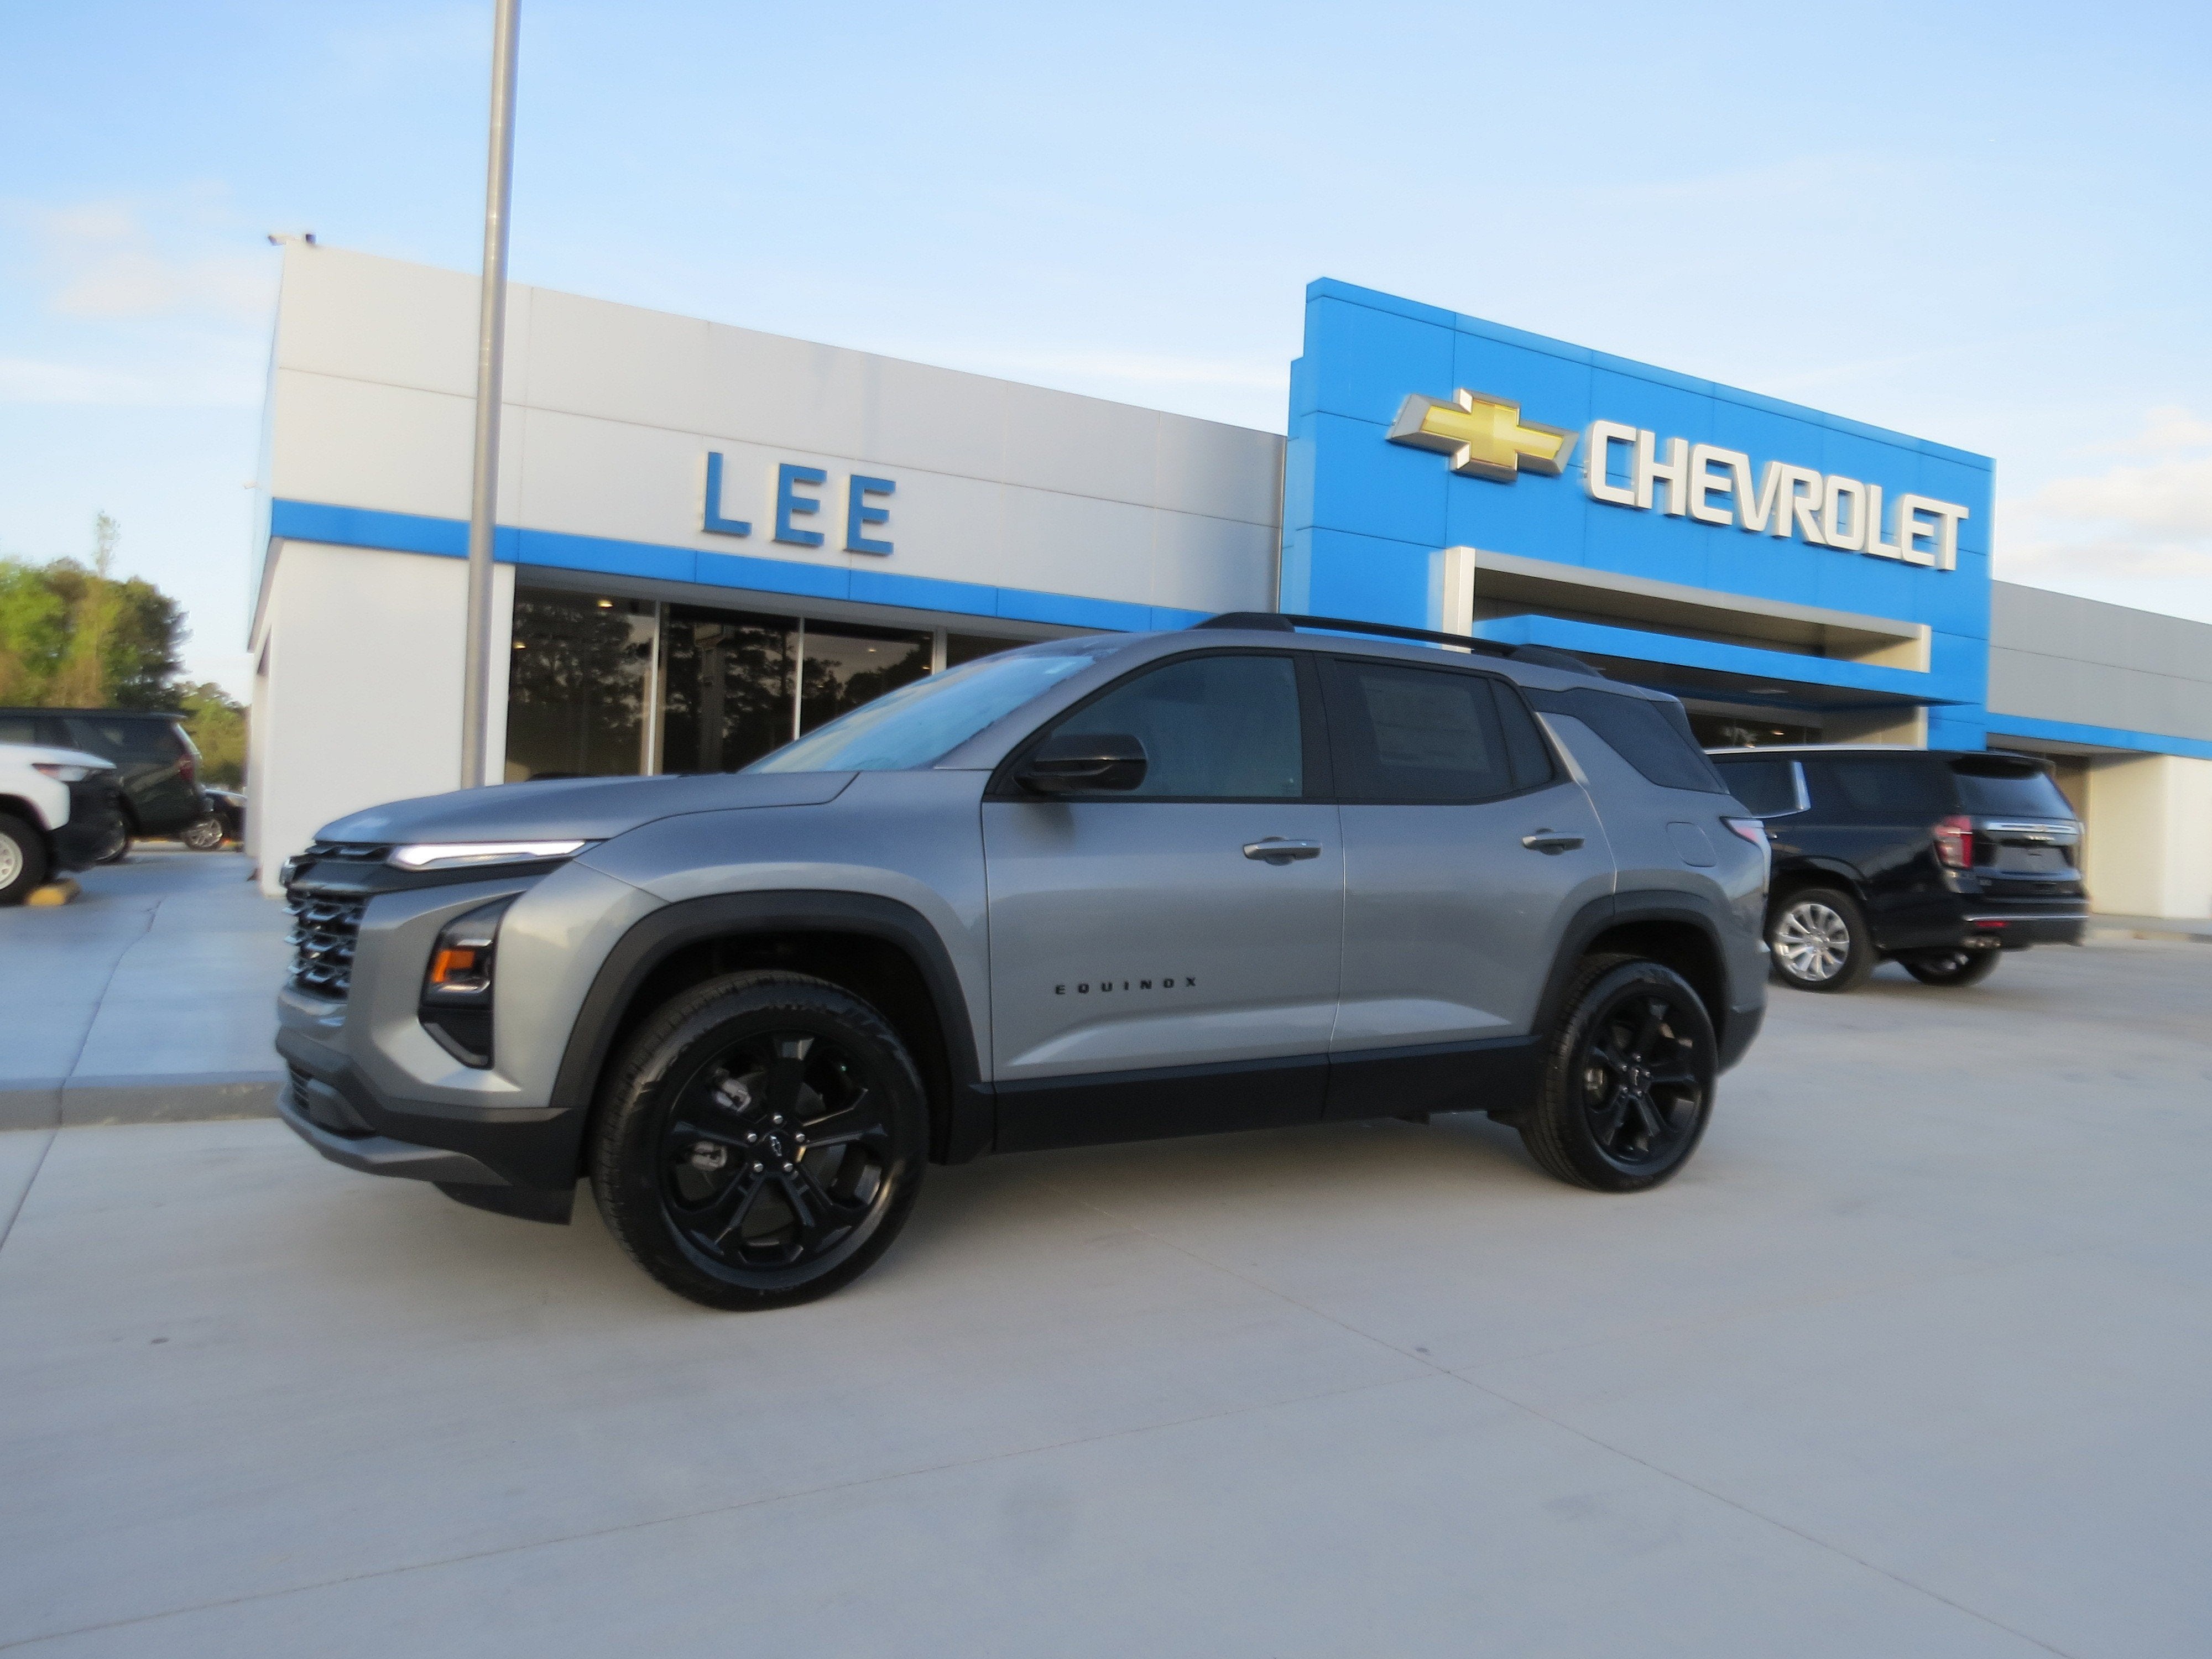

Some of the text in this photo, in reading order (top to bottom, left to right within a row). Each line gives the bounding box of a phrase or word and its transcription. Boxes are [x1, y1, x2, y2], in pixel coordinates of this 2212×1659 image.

[703, 451, 896, 556] LEE
[1586, 420, 1969, 571] CHEVROLET
[1055, 976, 1196, 995] EQUINOX
